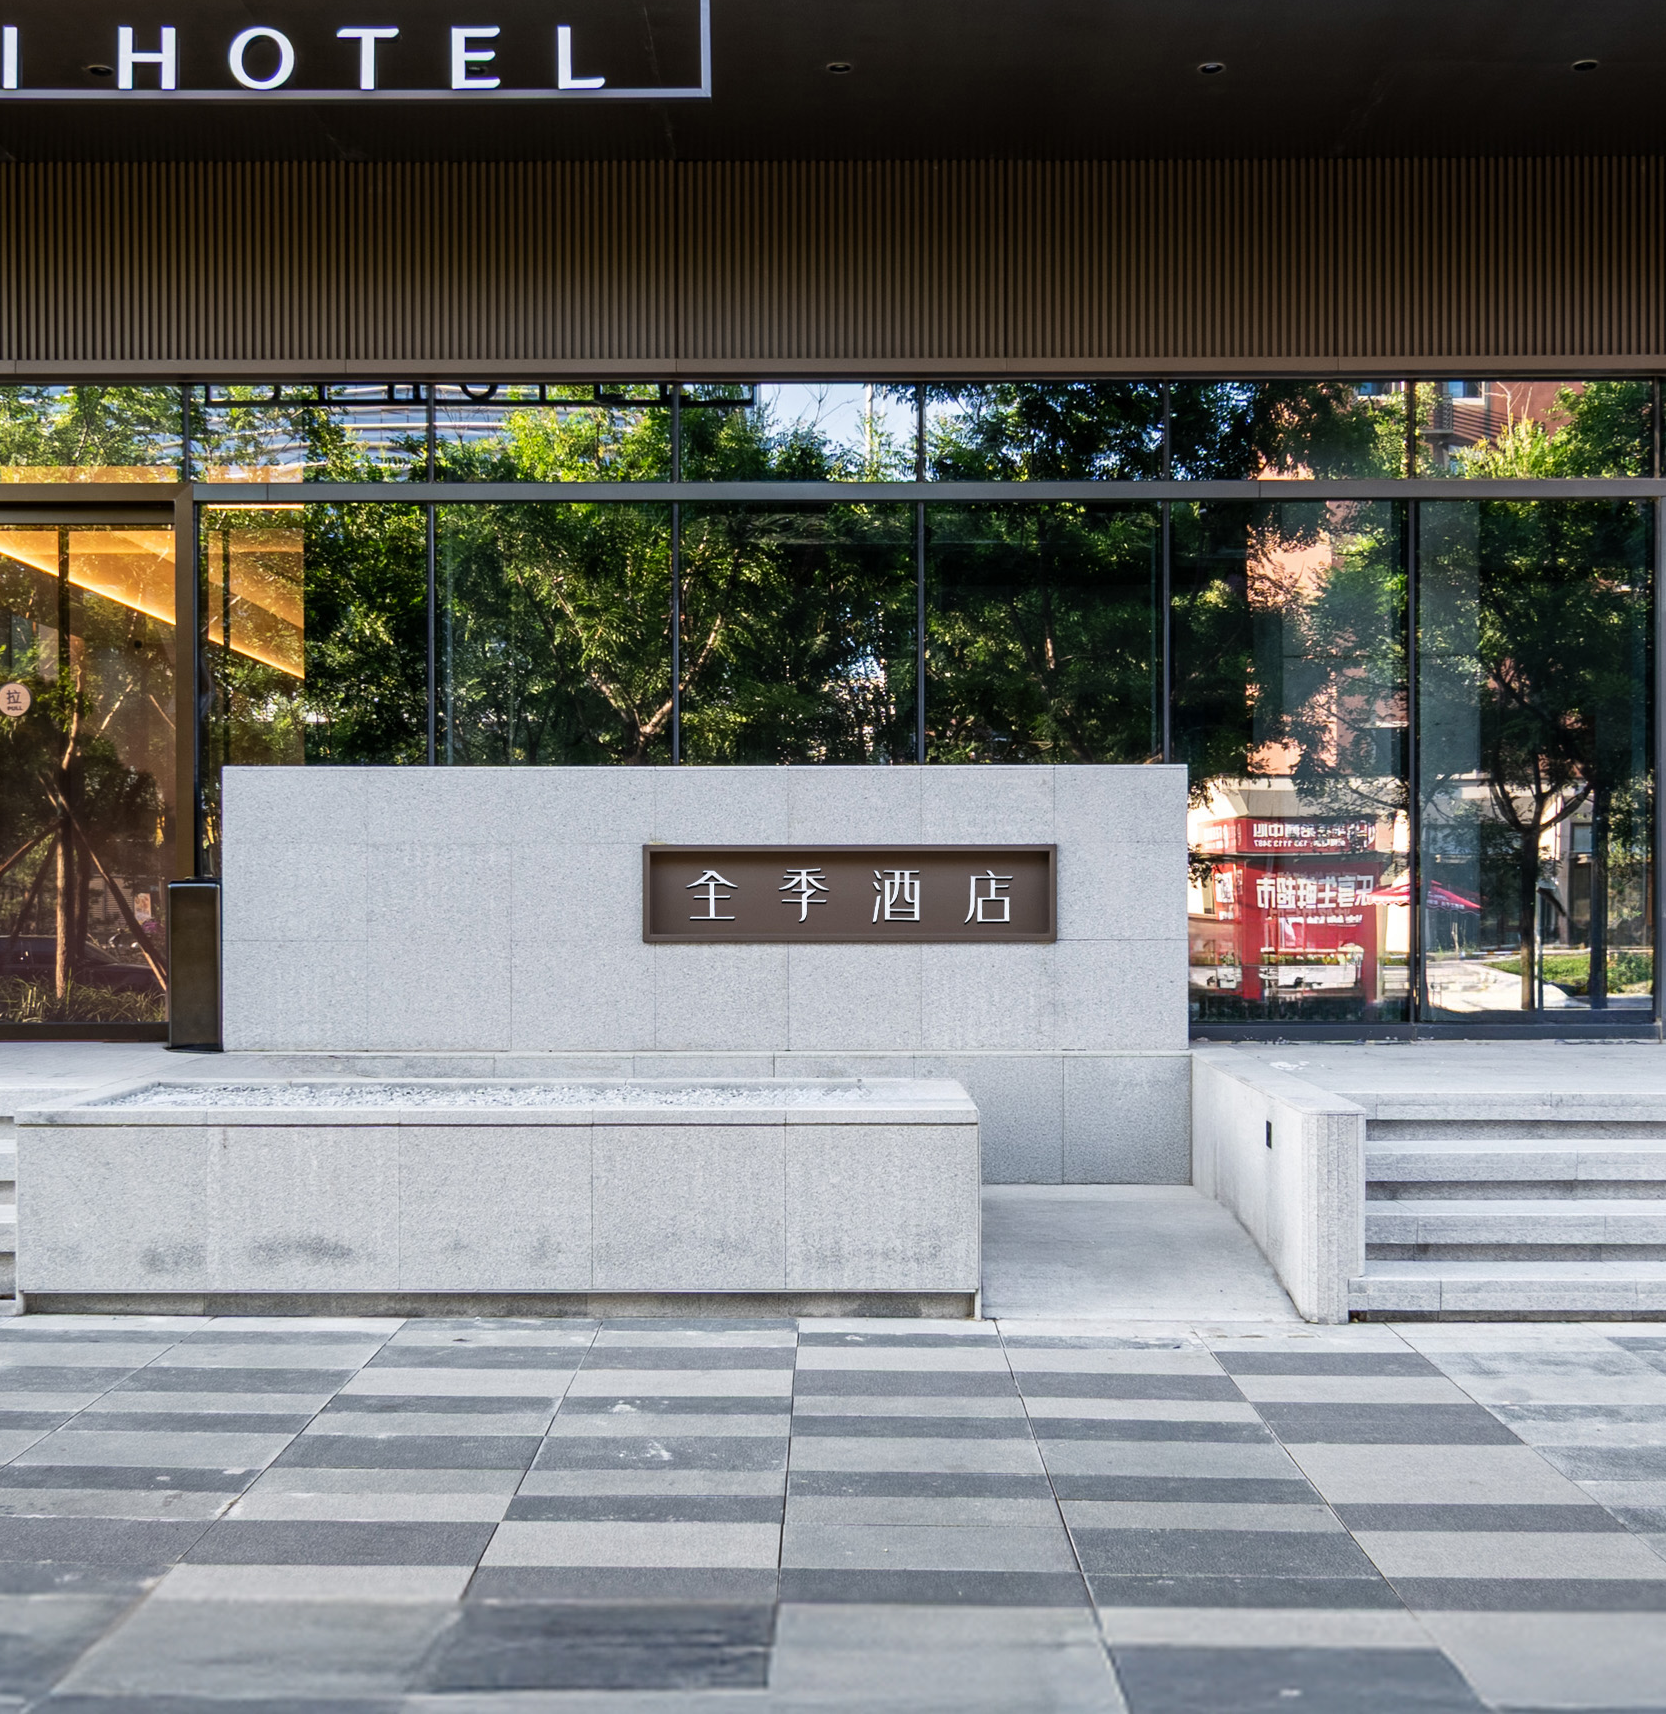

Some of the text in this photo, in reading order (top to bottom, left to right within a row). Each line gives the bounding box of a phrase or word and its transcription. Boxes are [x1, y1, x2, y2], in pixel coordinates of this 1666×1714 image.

[117, 25, 607, 91] HOTEL
[6, 689, 22, 705] 拉
[686, 868, 1013, 924] 全季酒店
